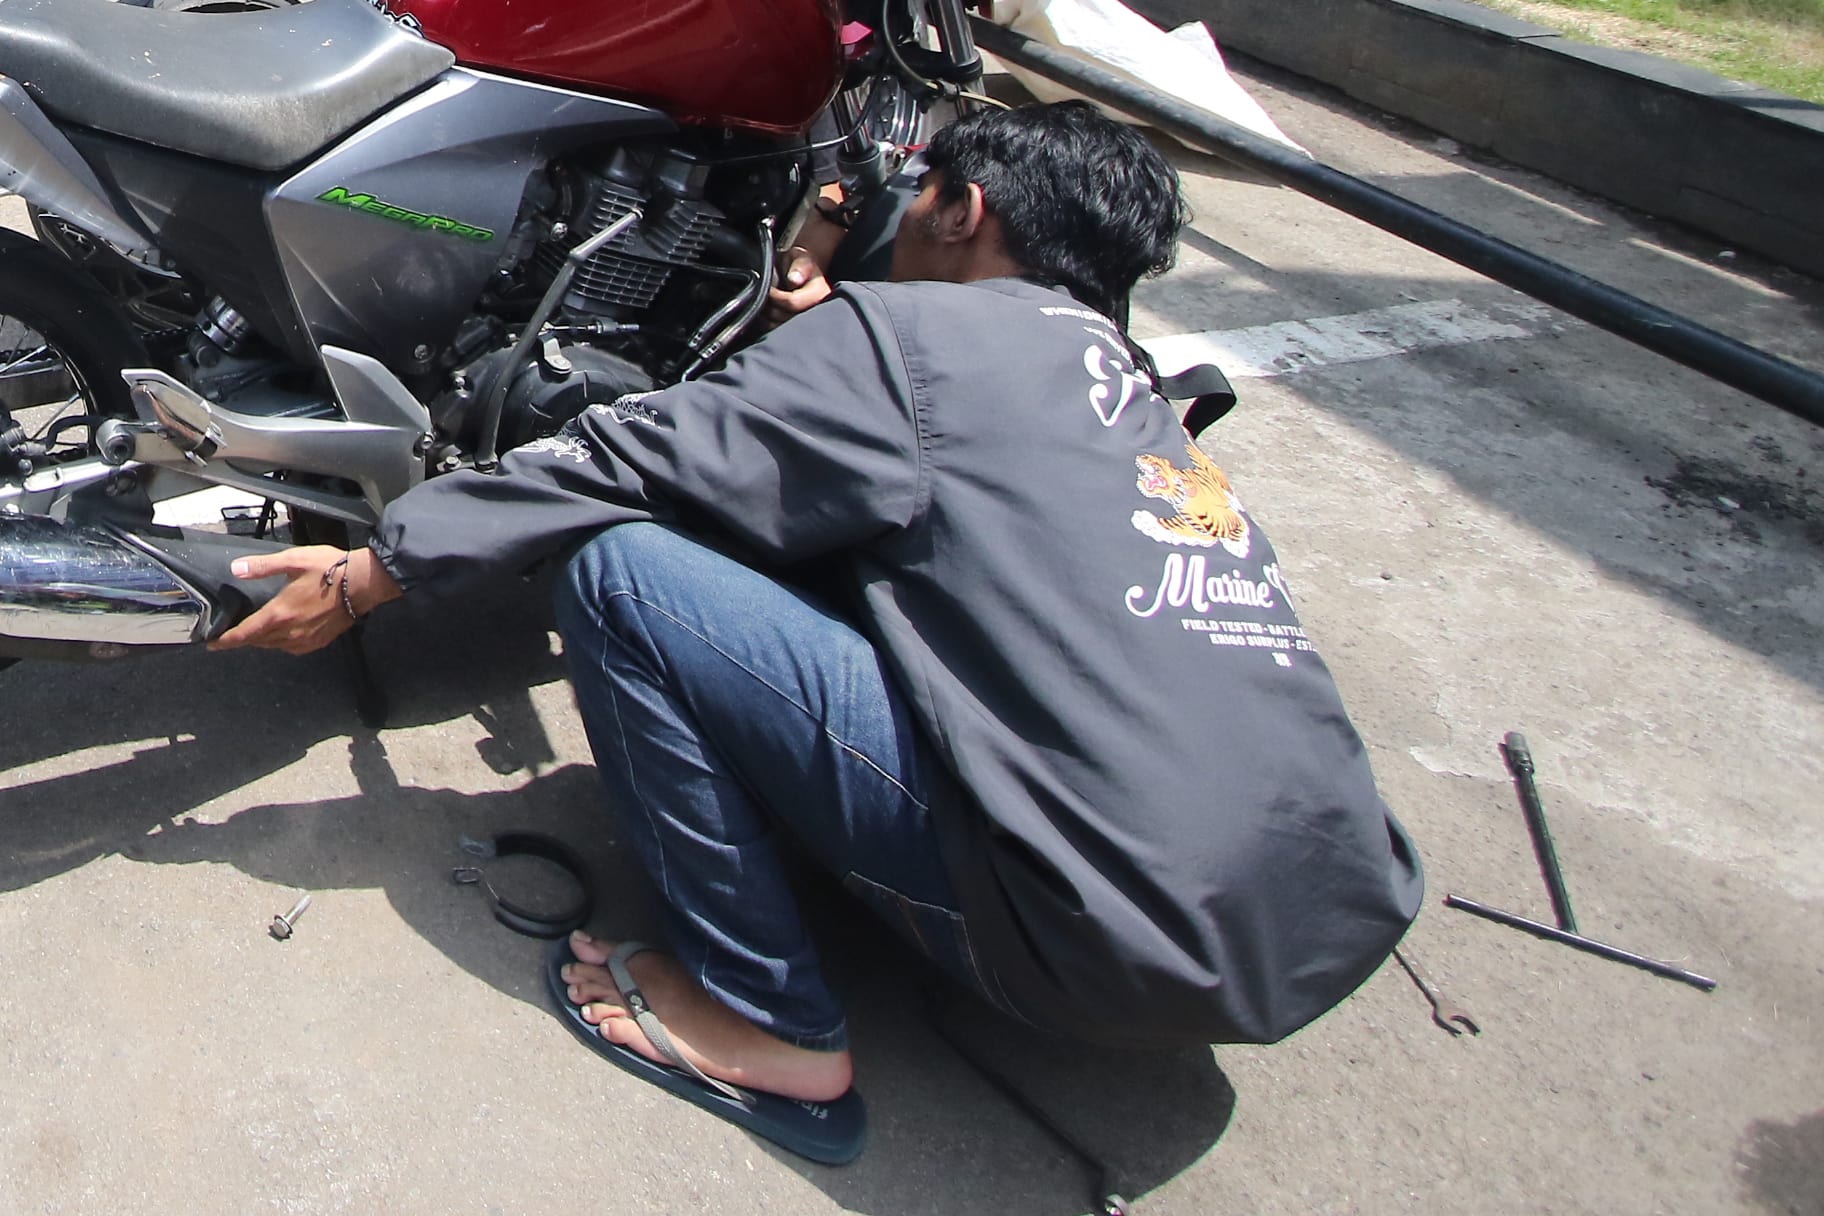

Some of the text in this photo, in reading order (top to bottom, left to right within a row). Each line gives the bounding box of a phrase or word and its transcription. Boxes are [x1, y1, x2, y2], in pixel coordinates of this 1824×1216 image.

[1125, 553, 1274, 618] Marine
[1181, 618, 1220, 632] FIELD
[1219, 620, 1263, 634] TESTED
[1208, 633, 1246, 646] ERIGO
[1246, 635, 1290, 650] SURPLUS
